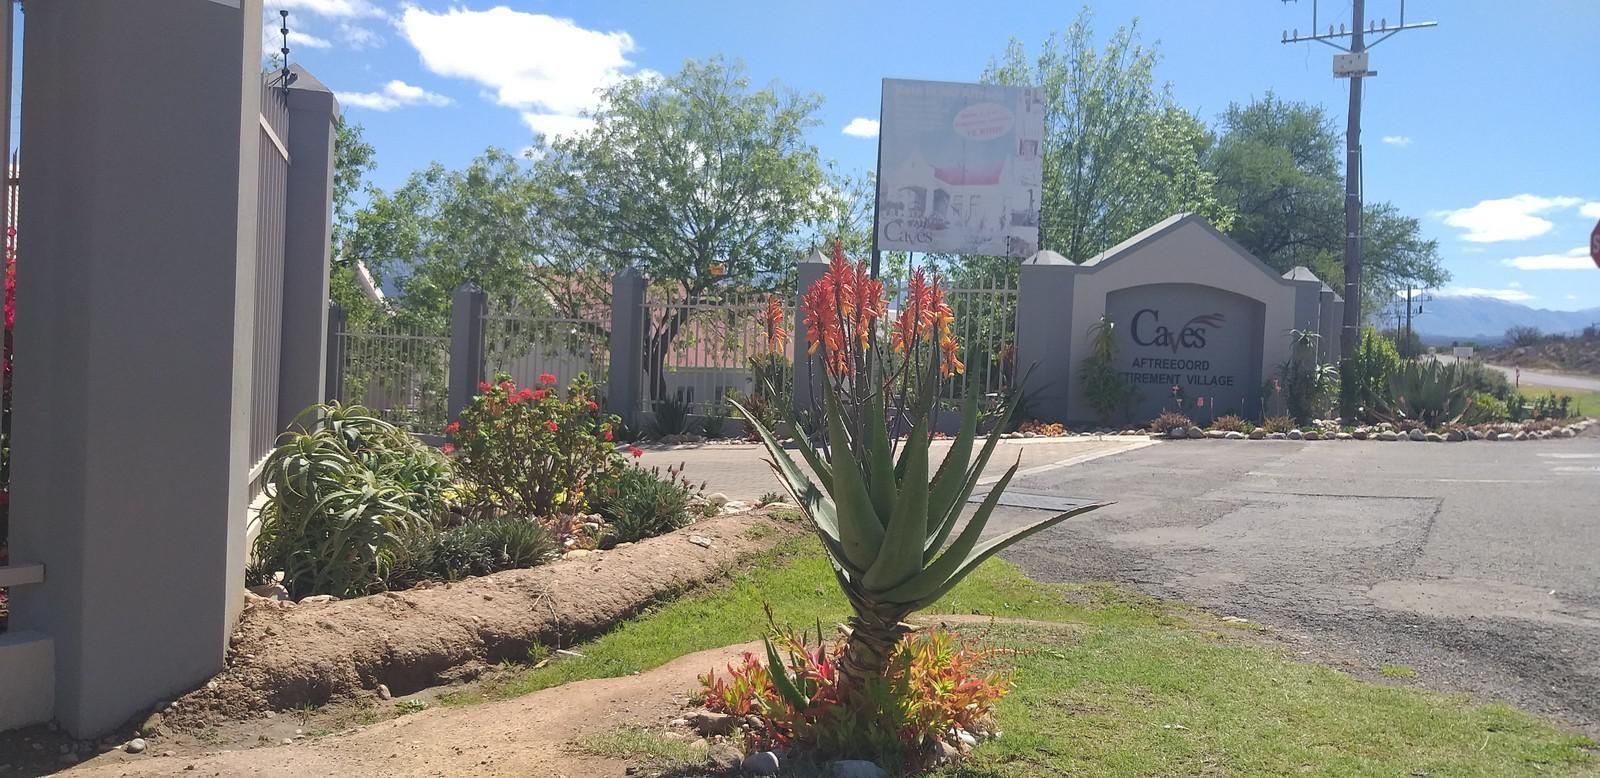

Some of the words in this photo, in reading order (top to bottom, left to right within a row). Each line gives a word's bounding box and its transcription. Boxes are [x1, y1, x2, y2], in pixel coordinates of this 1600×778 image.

[884, 220, 933, 244] Caves
[1130, 308, 1207, 354] Caves
[1132, 357, 1210, 371] AFTREEOORD
[1116, 372, 1181, 385] TIREMENT
[1187, 374, 1235, 386] VILLAGE
